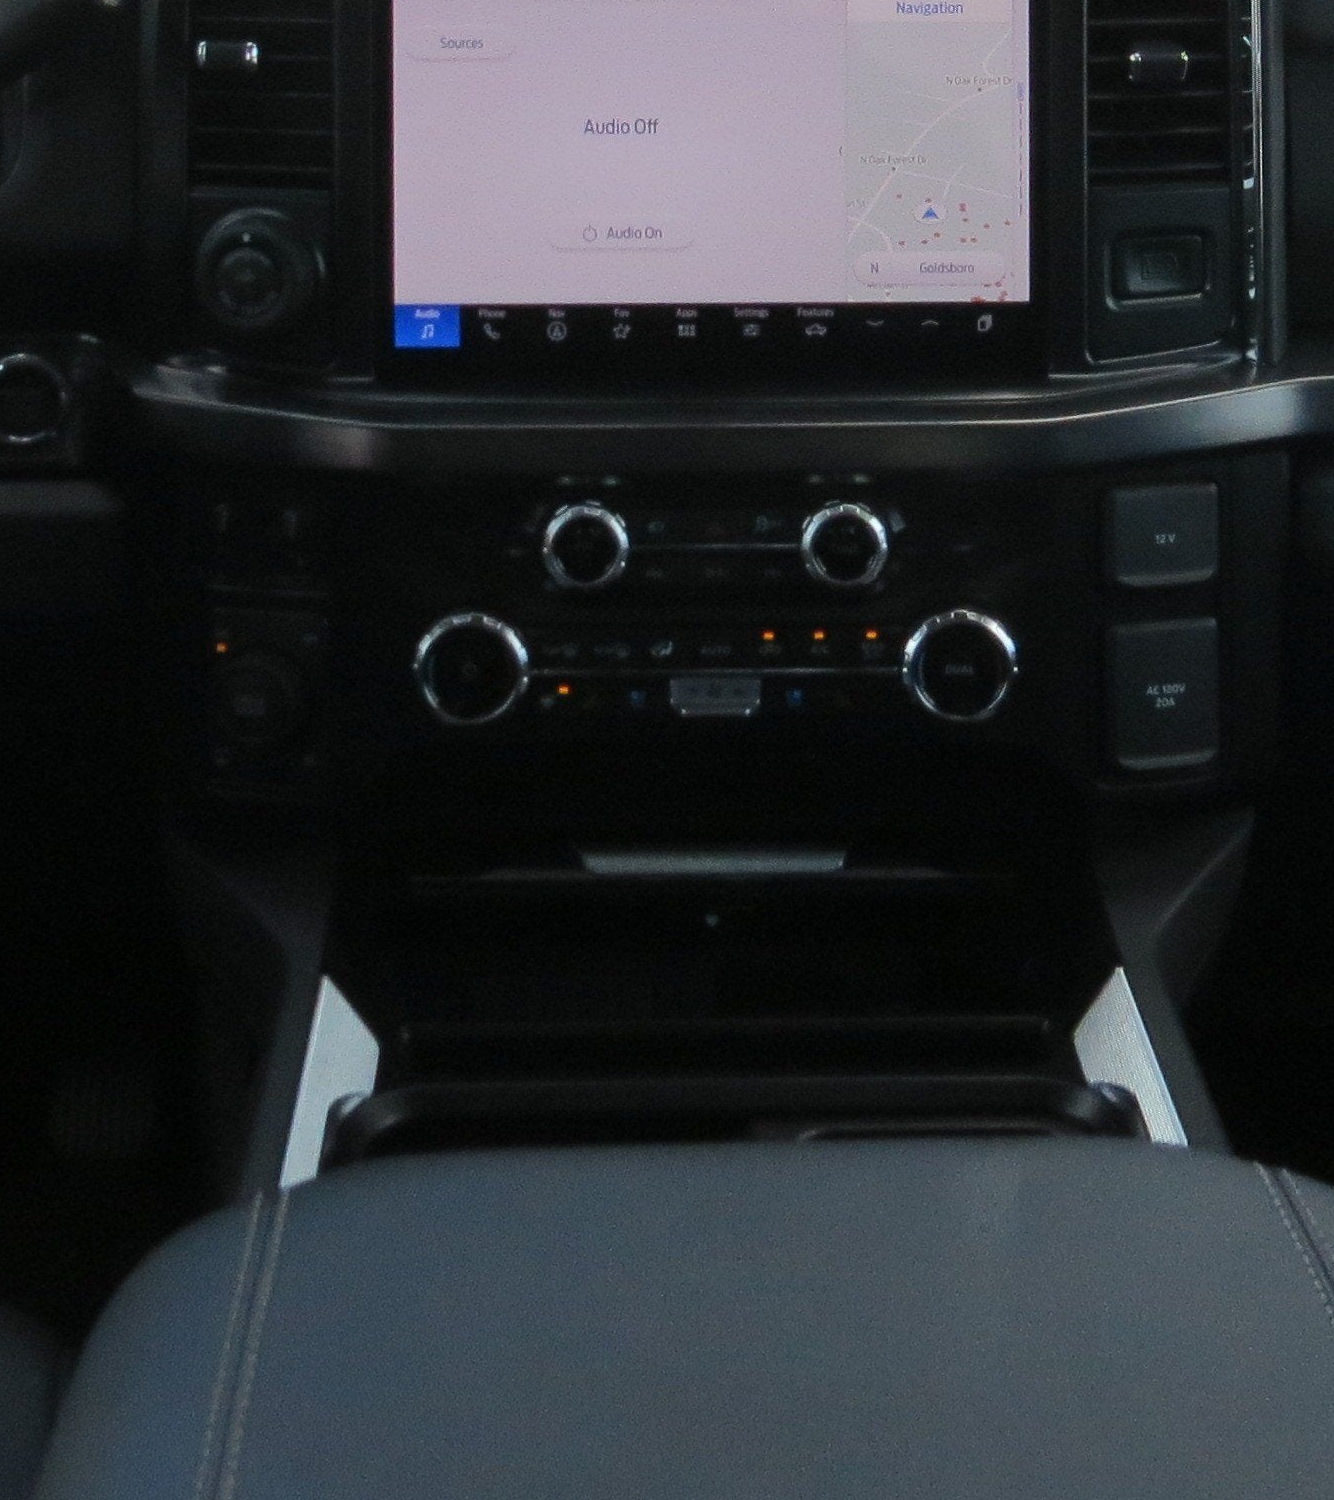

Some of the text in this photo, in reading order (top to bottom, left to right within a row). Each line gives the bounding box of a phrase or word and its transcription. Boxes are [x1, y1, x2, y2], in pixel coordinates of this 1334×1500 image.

[896, 1, 963, 17] Navigation
[440, 37, 484, 49] Sources
[584, 118, 659, 135] Audio Off
[606, 226, 662, 240] Audio On
[870, 262, 974, 274] N Goldsboro
[1155, 533, 1176, 545] 12 V
[1146, 685, 1161, 695] AC
